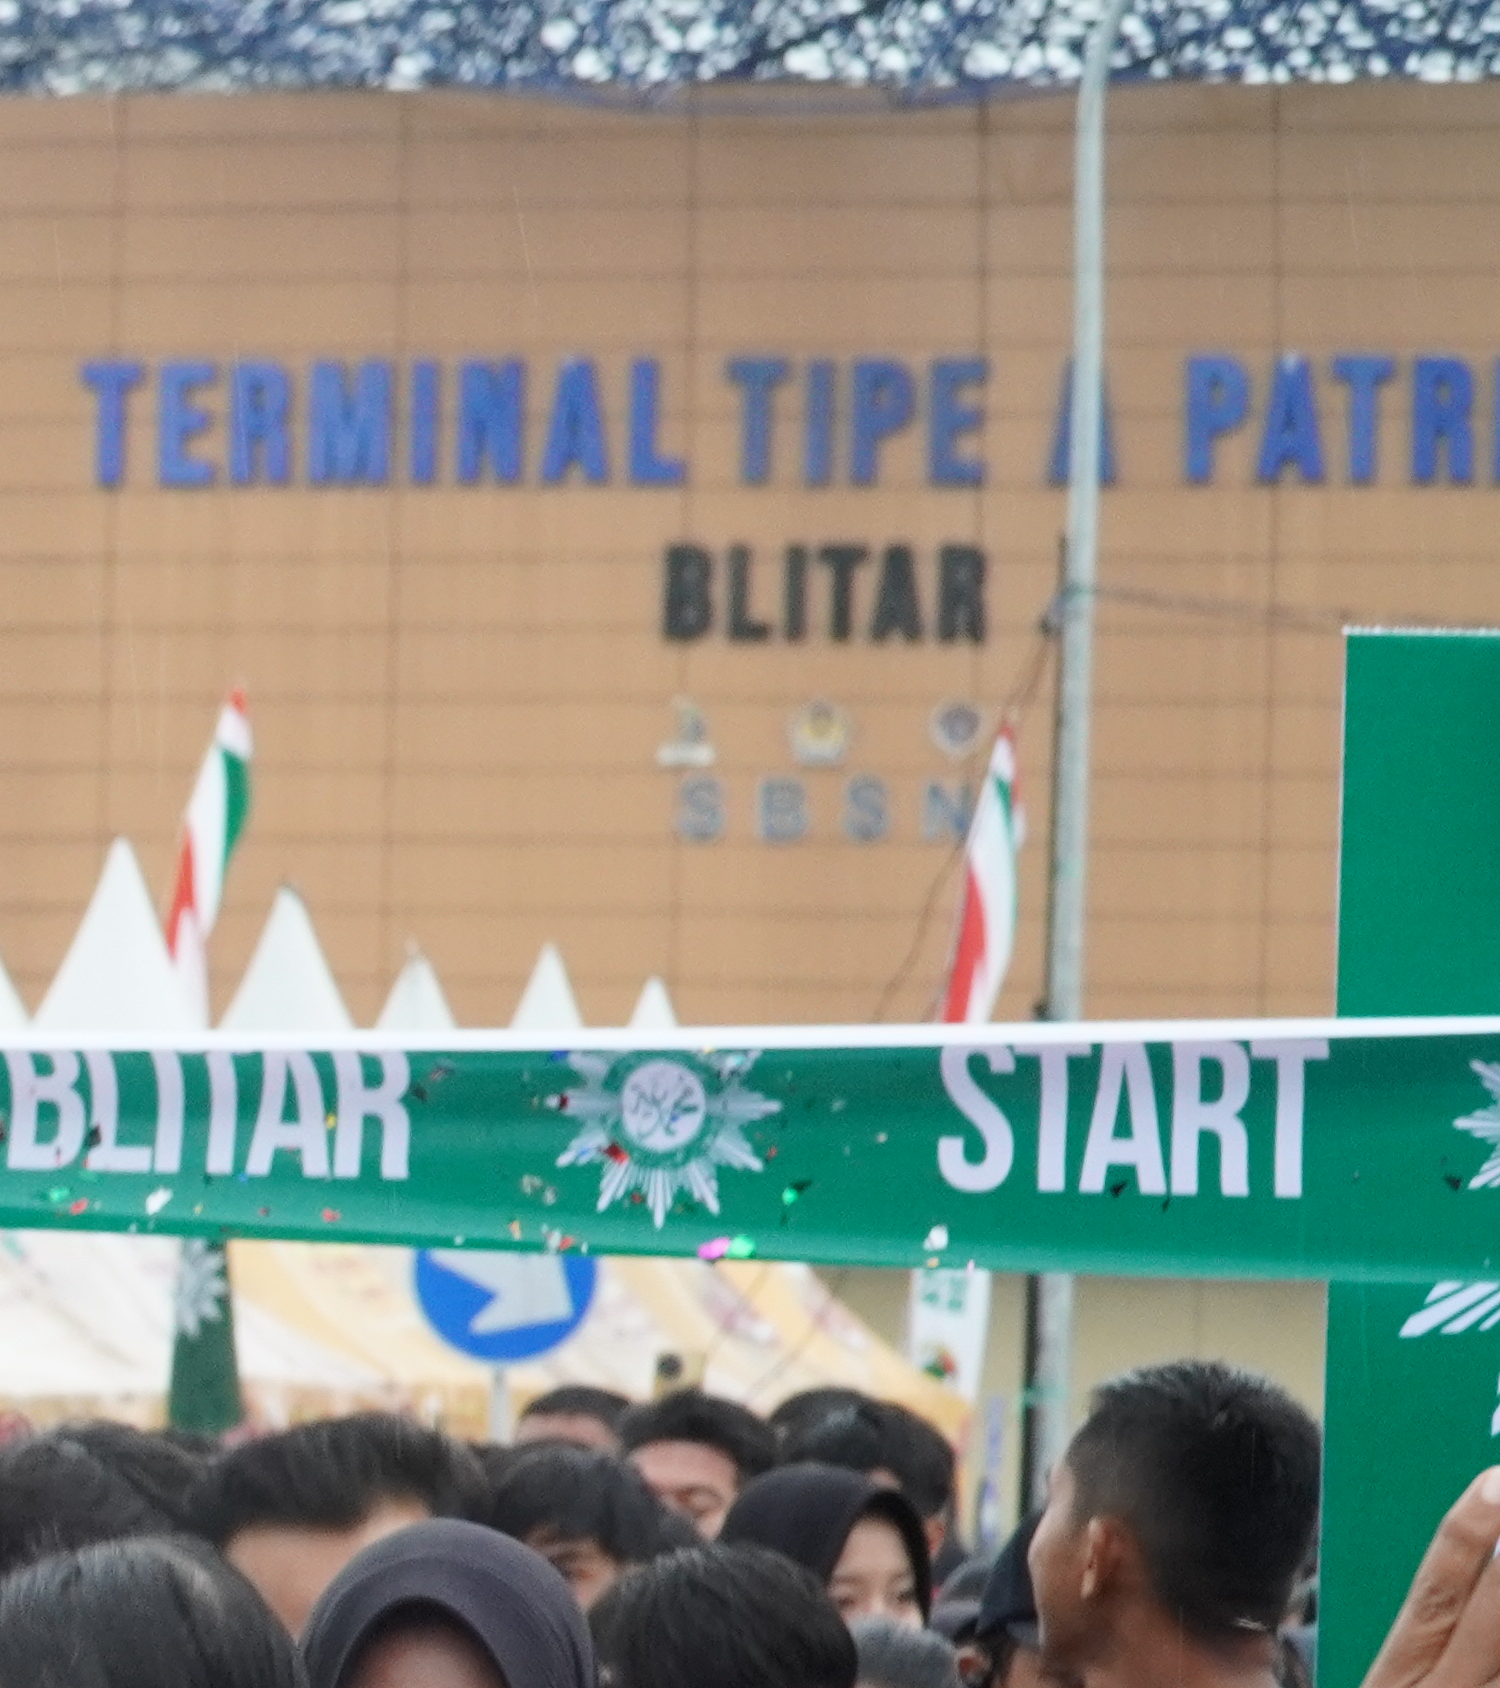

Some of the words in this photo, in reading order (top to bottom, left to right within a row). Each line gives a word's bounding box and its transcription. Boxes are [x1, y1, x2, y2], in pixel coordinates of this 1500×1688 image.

[81, 358, 683, 484] TERMINAL
[728, 356, 990, 483] TIPE
[1184, 355, 1500, 484] PATR
[662, 543, 987, 643] BLITAR
[6, 1050, 410, 1181] BLITAR
[936, 1040, 1330, 1198] START
